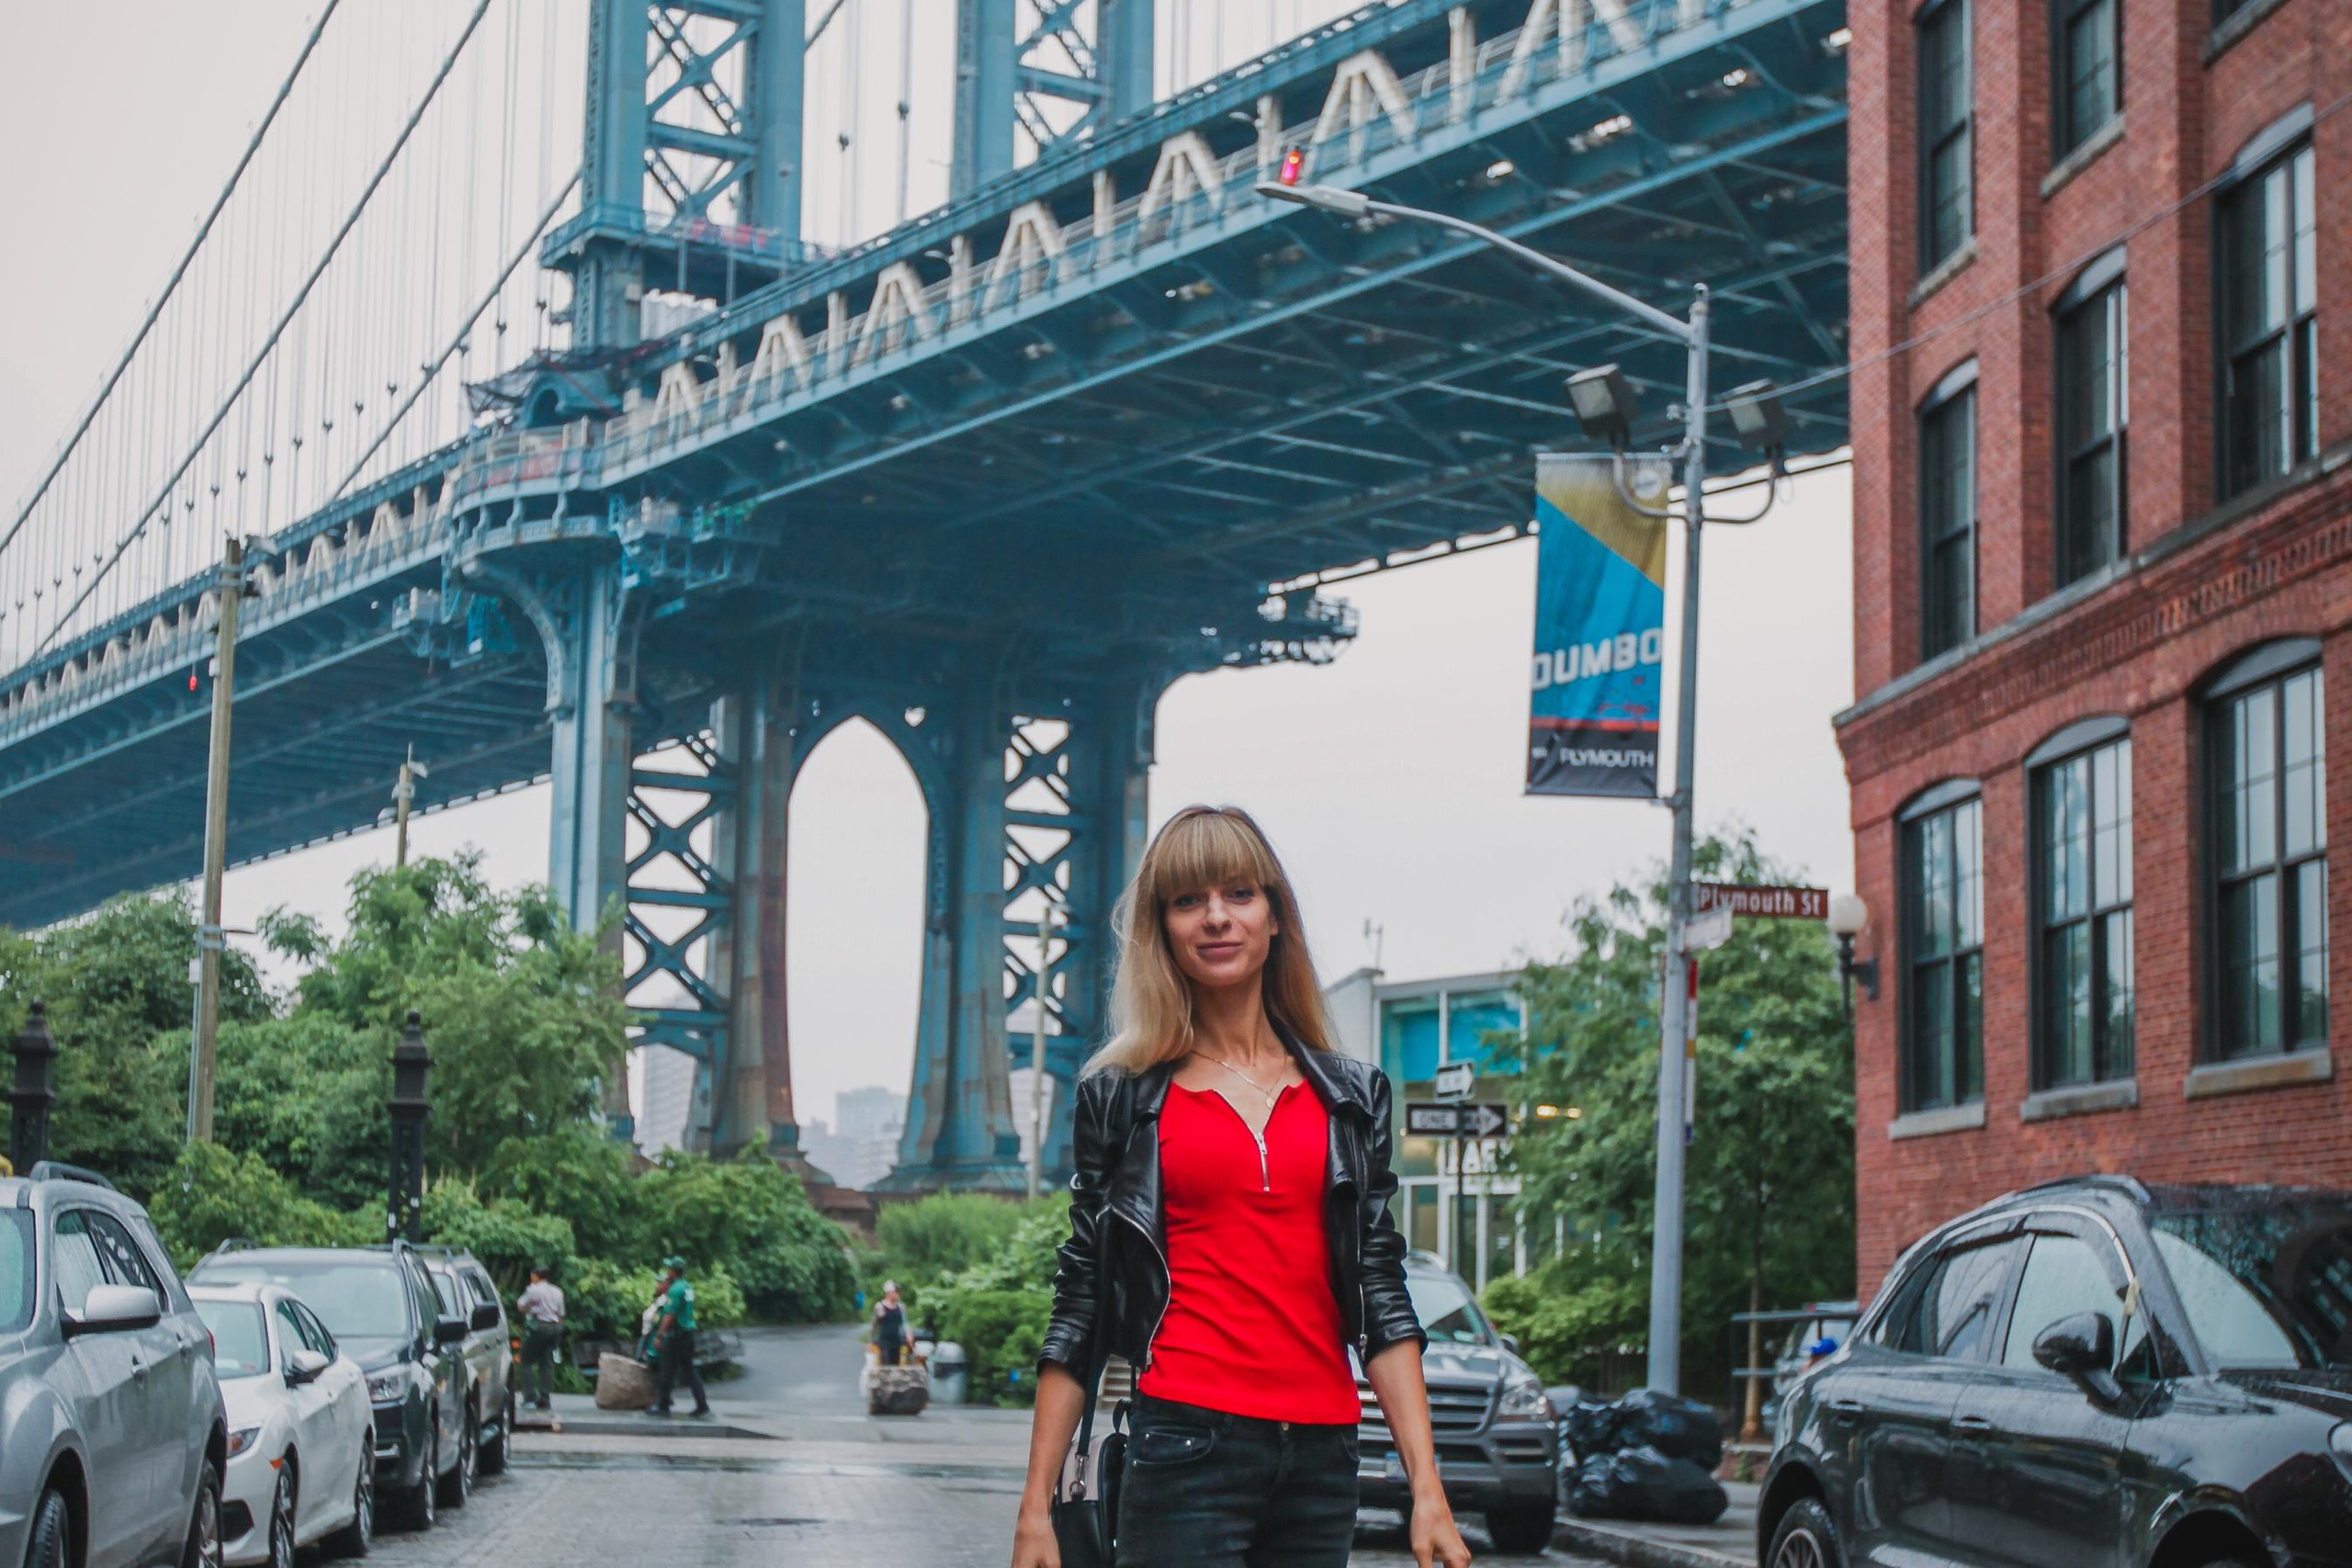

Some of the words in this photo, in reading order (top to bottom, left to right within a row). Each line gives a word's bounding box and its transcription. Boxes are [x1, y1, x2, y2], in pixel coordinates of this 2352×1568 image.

[1532, 626, 1663, 691] DUMBO
[1559, 748, 1655, 768] PLYMOUTH
[1800, 891, 1821, 916] St
